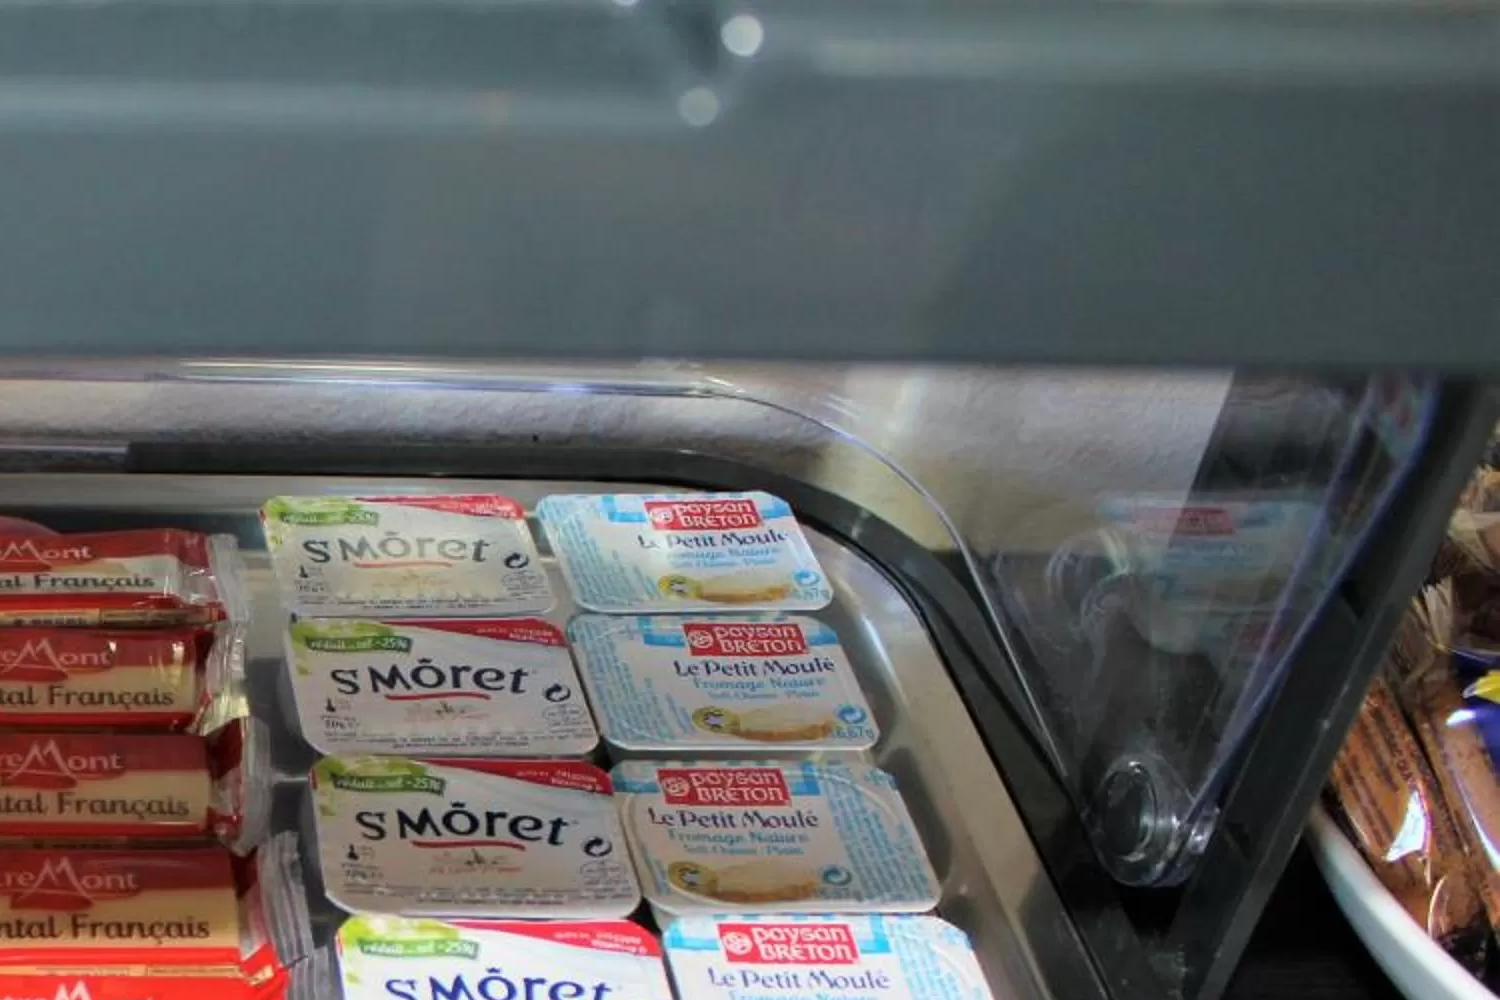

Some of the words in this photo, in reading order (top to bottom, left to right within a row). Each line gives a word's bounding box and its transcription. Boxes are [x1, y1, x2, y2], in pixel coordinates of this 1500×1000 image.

[33, 572, 155, 595] Français
[673, 660, 701, 678] Le
[704, 661, 758, 678] Petit
[764, 659, 835, 676] Moulé
[47, 684, 175, 711] Français
[57, 792, 190, 820] Français
[648, 807, 674, 827] Le
[676, 811, 736, 828] Petit
[742, 808, 819, 828] Moulé
[70, 914, 211, 946] Français
[708, 966, 735, 986] Le
[740, 969, 802, 989] Petit
[807, 969, 892, 990] Moulé
